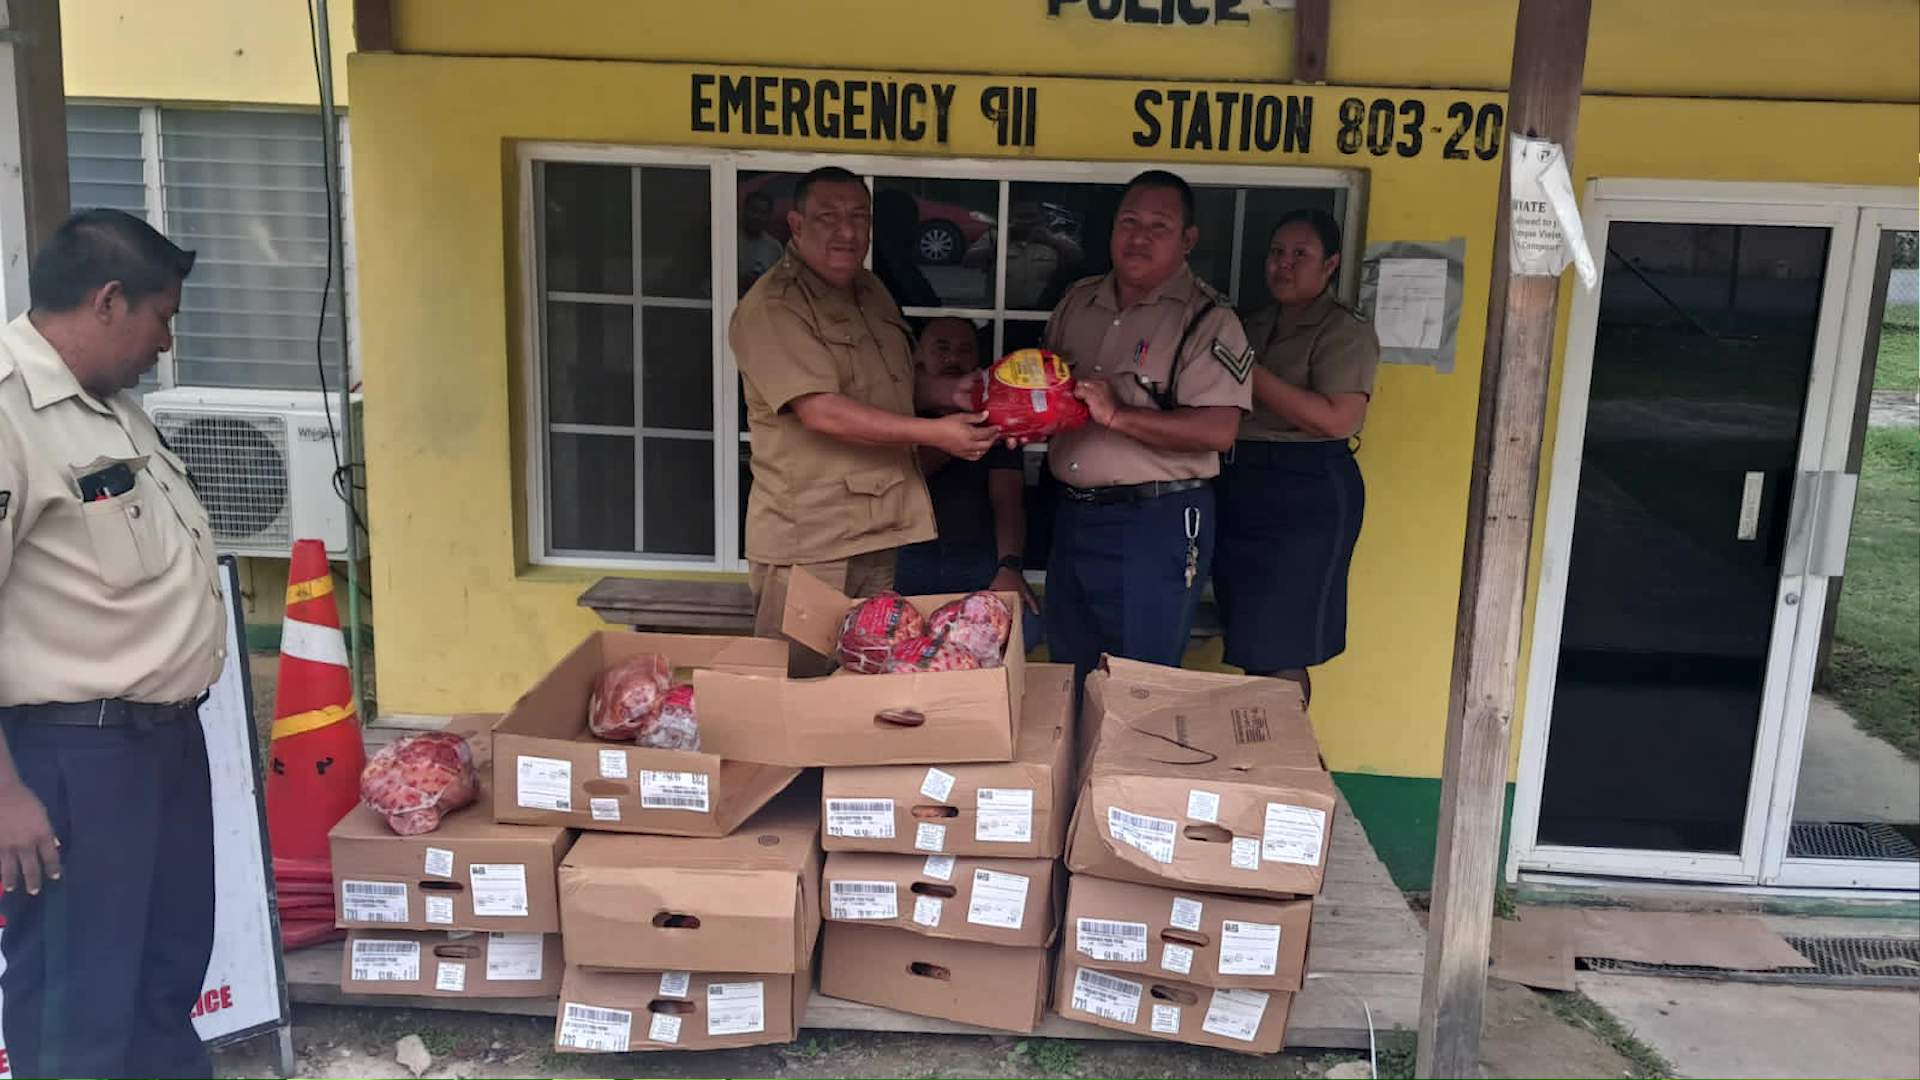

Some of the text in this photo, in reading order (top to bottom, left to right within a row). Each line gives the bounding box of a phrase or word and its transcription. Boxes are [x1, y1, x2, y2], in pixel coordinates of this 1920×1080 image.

[691, 73, 956, 143] EMERGENCY
[981, 86, 1037, 147] 911
[1133, 89, 1313, 154] STATION
[190, 985, 234, 1019] ICE
